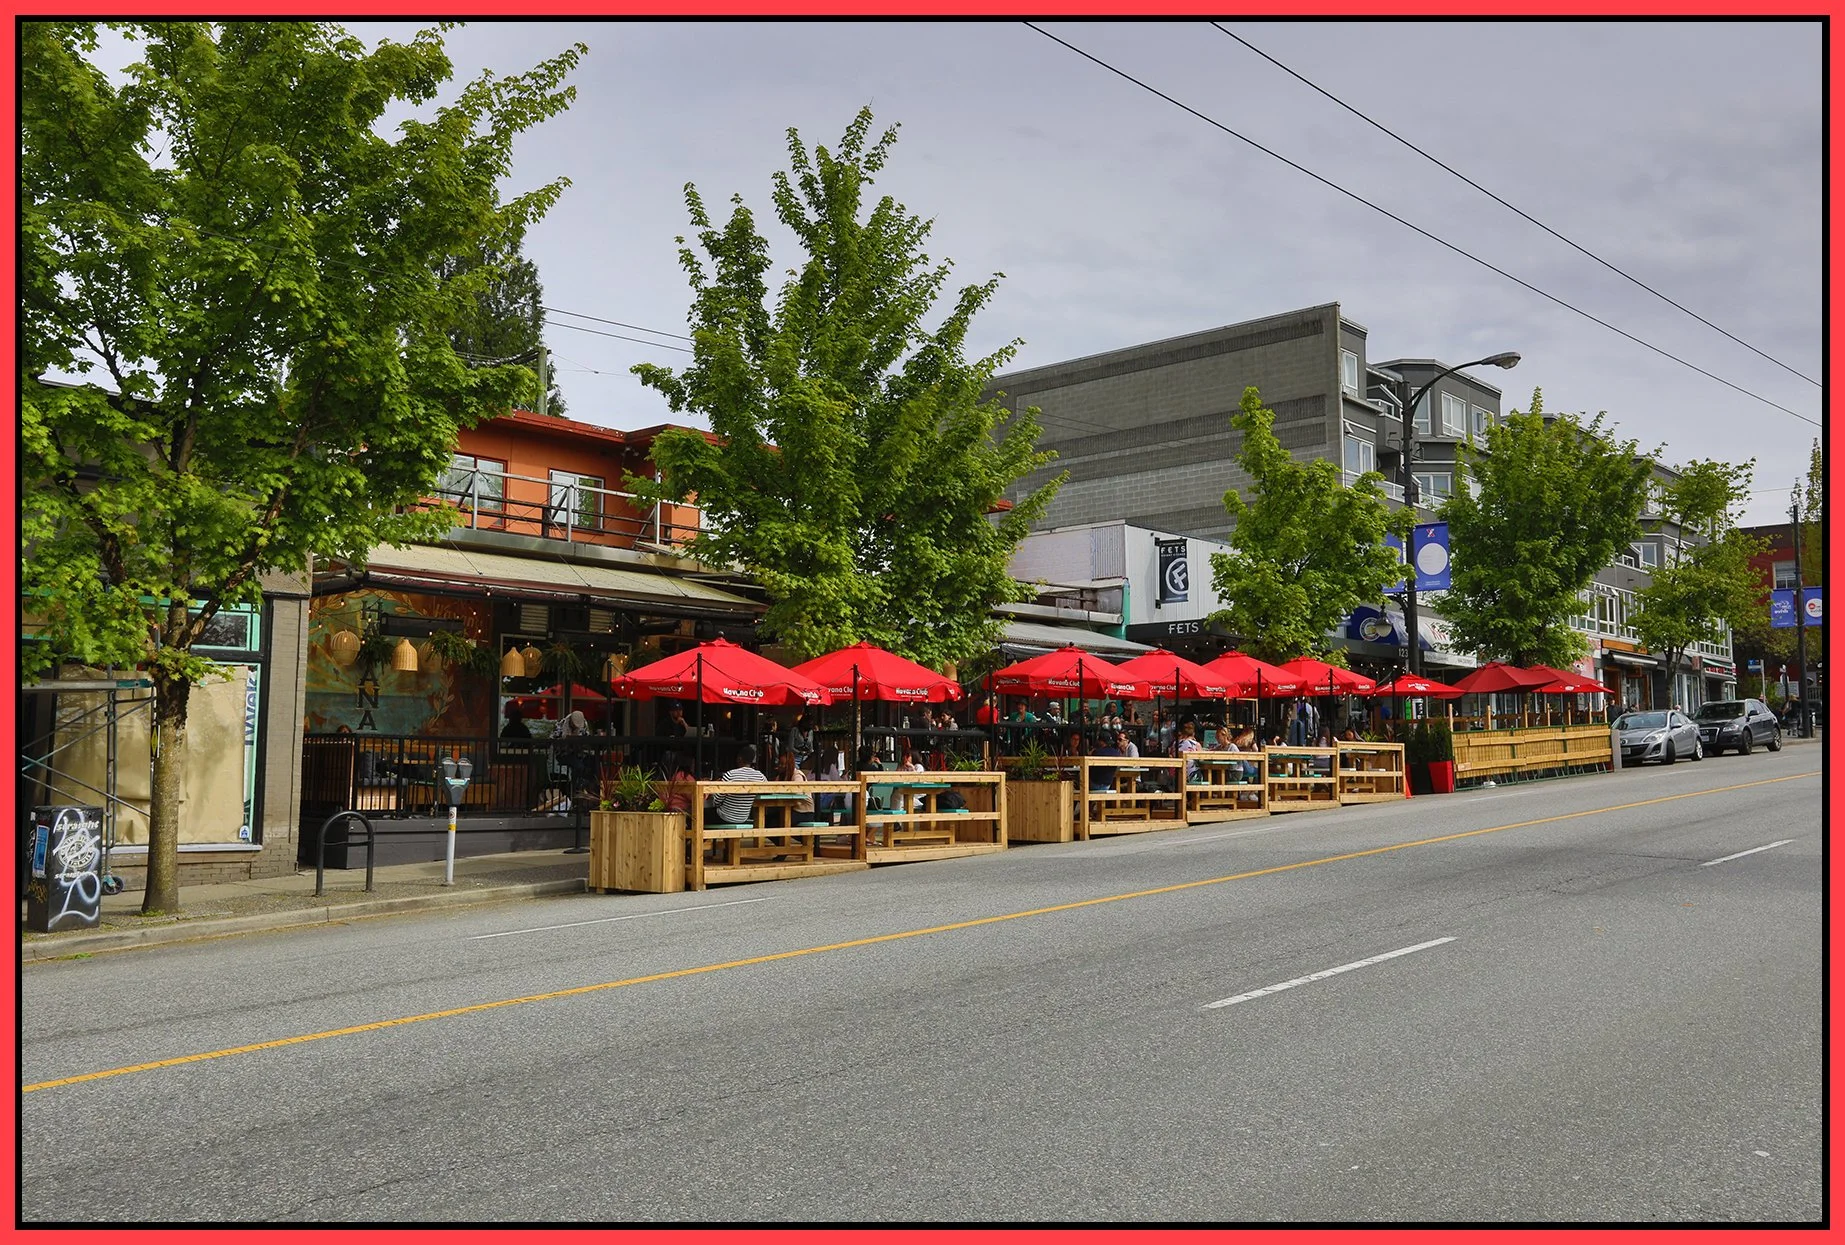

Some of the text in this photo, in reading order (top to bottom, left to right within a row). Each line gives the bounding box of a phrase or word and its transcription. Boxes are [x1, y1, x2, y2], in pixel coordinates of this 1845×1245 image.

[1161, 546, 1186, 554] FETS
[1168, 622, 1199, 634] FETS
[356, 600, 383, 731] HAANA
[723, 687, 764, 698] Havana Club
[56, 820, 100, 831] sraight
